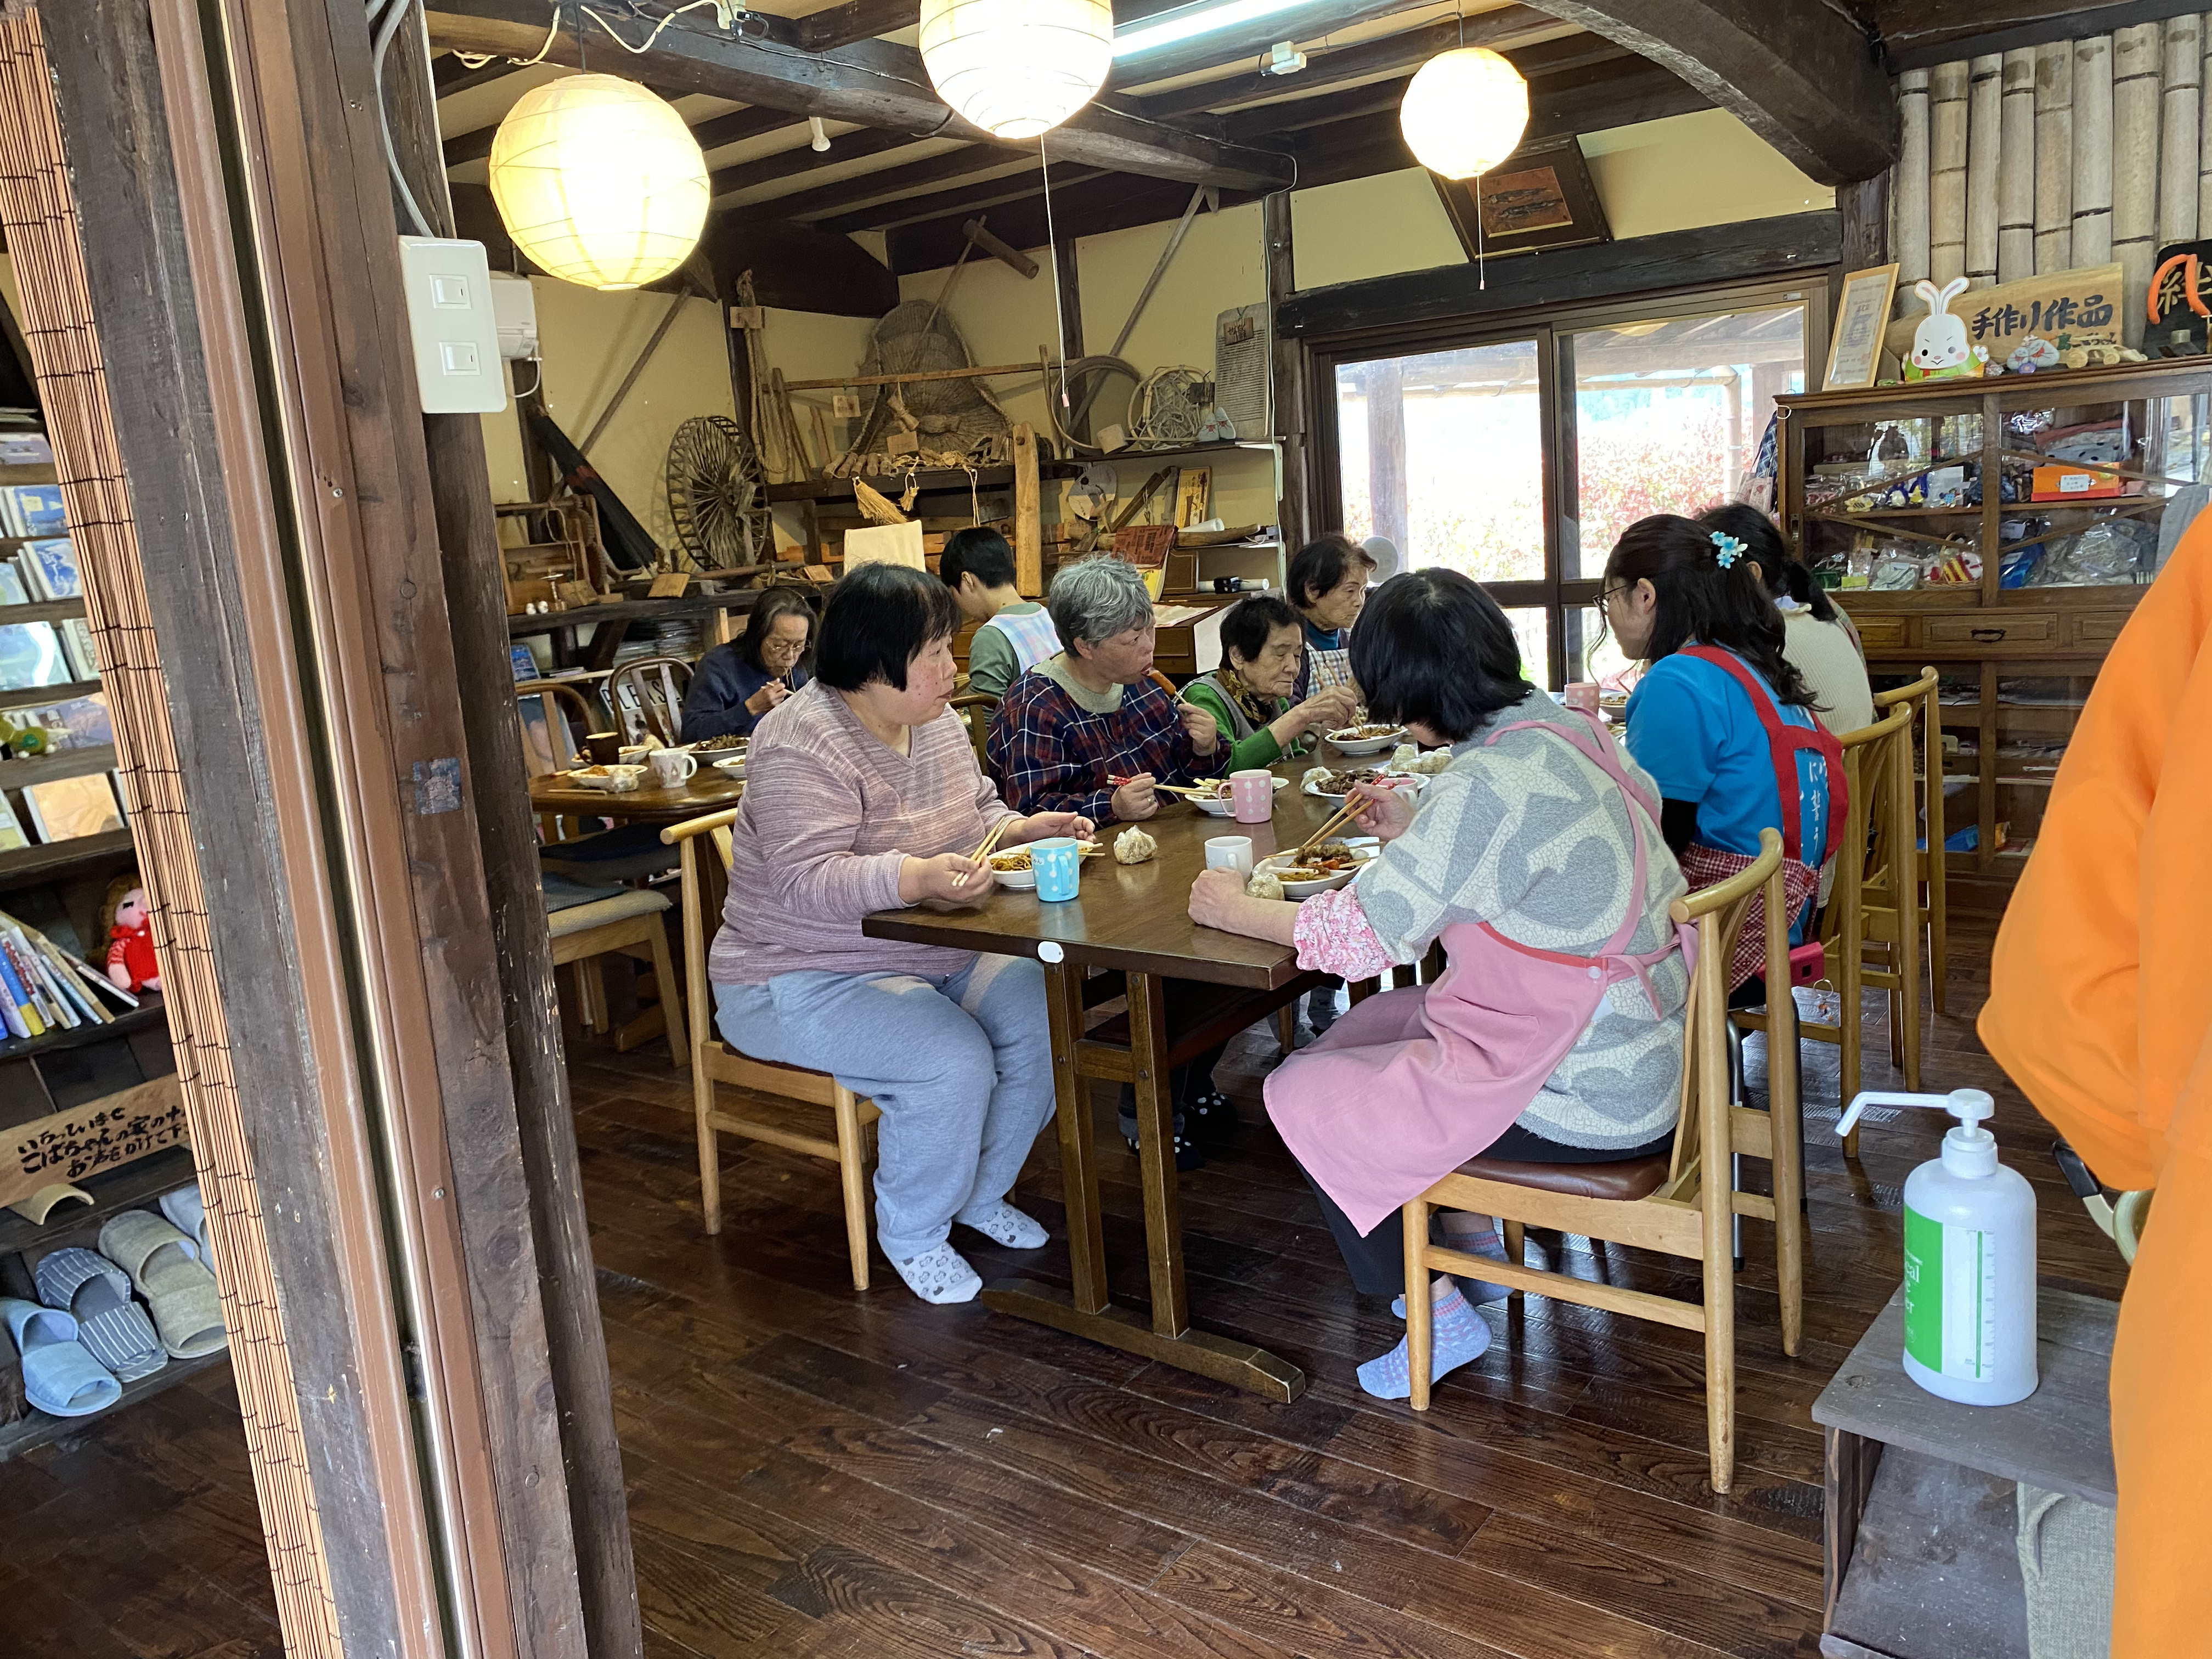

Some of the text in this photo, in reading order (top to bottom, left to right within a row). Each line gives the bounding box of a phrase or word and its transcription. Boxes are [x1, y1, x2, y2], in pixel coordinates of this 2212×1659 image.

[1972, 294, 2113, 340] 手作り作品
[601, 680, 681, 709] PLES
